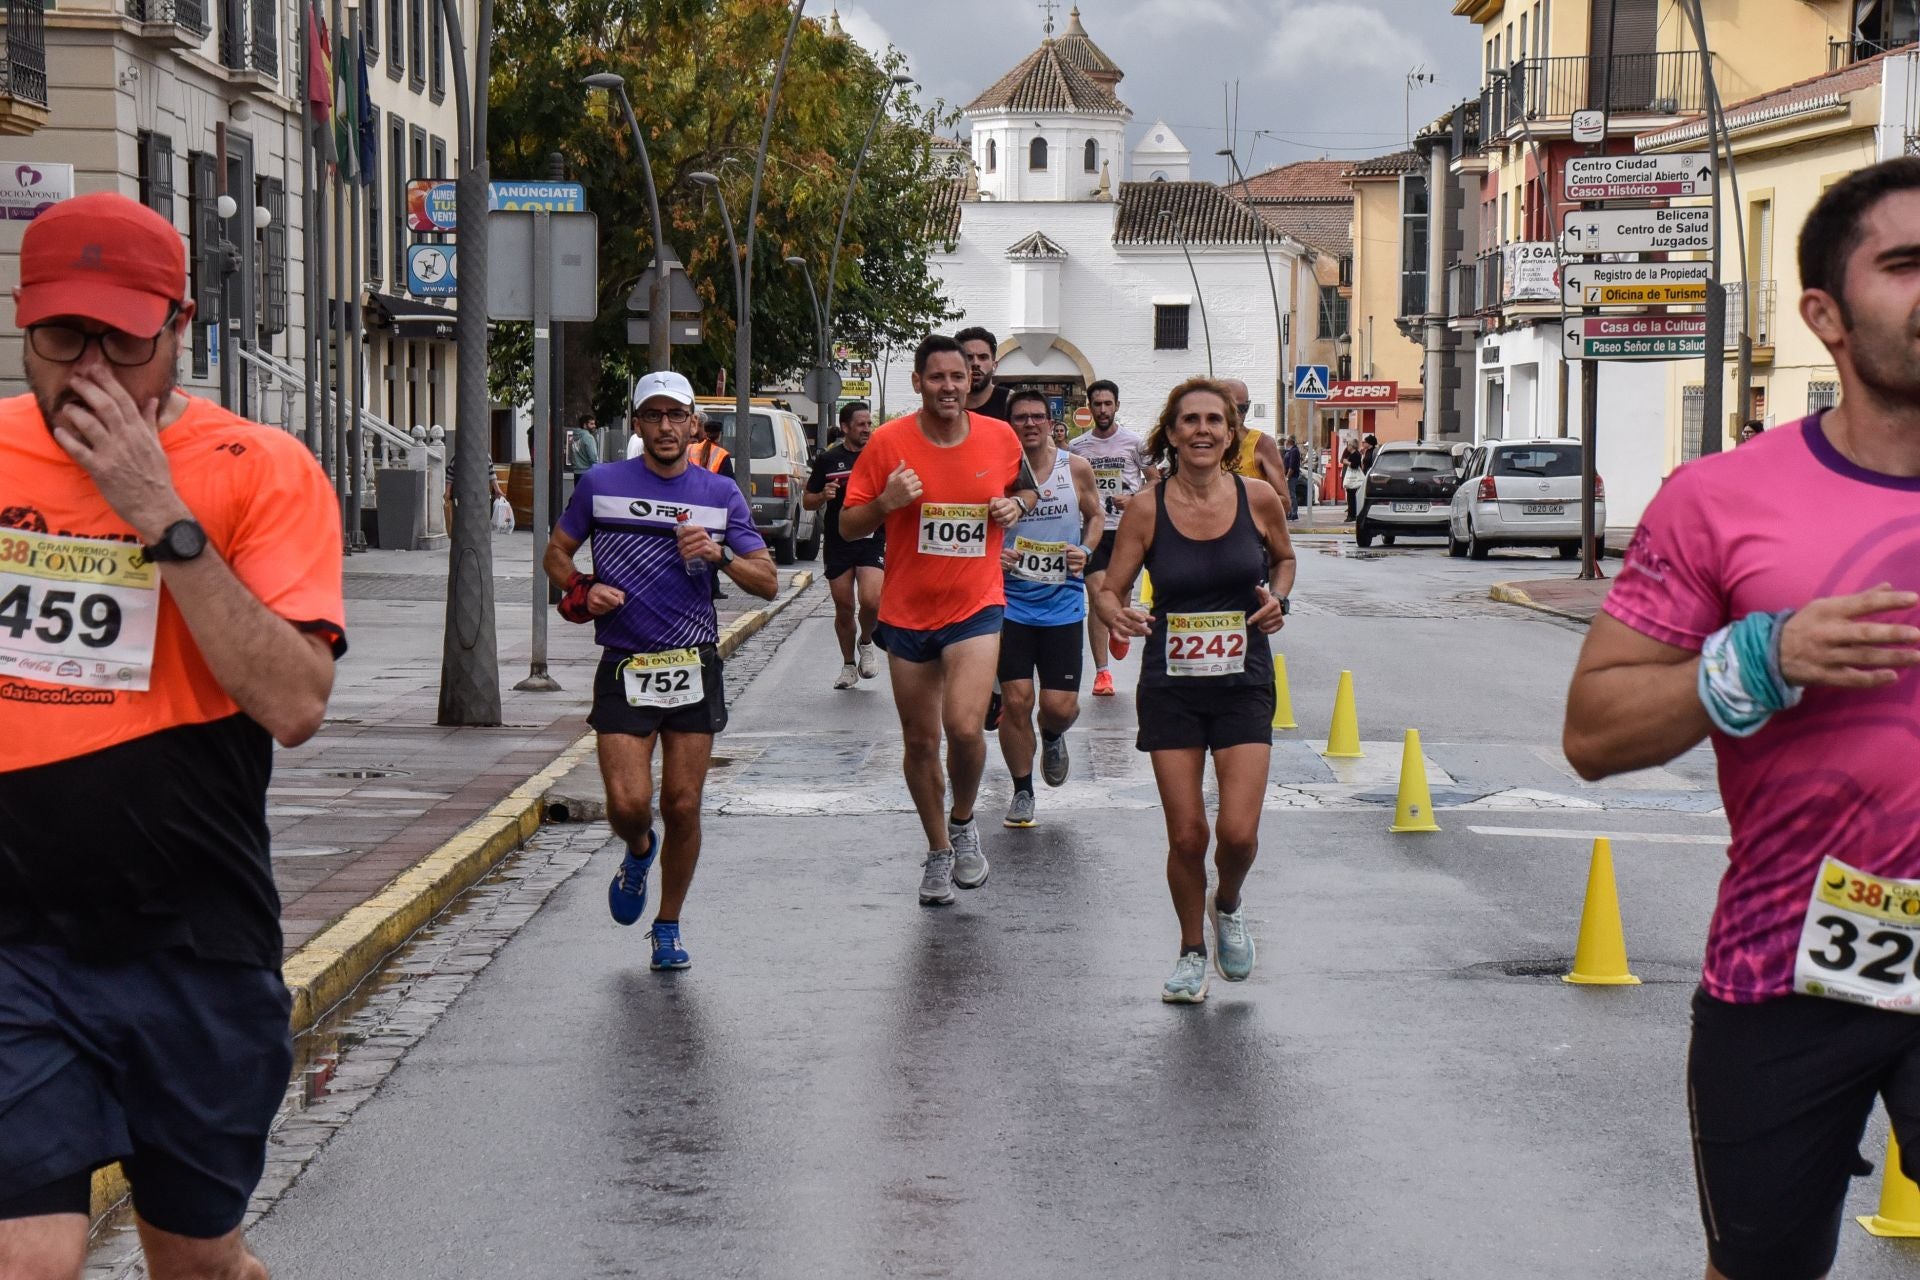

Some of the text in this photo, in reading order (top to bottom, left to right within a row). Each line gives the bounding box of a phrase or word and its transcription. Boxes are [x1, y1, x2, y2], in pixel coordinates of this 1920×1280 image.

[1572, 159, 1657, 171] Centro Ciudad
[1572, 171, 1689, 184] Centro Comercial Abierto
[499, 185, 577, 198] ANÚNCIATE
[1570, 184, 1657, 197] Casco Histórico
[1657, 210, 1709, 220] Belicena
[1617, 223, 1708, 235] Centro de Salud
[1650, 236, 1708, 248] Juzgados
[1522, 248, 1529, 258] 3
[1594, 268, 1707, 282] Registro de la Propiedad
[1606, 289, 1643, 301] Oficina
[1647, 289, 1661, 300] de
[1665, 288, 1706, 299] Turismo
[1600, 321, 1705, 333] Casa de la Cultura
[1593, 339, 1705, 352] Paseo Señor de la Salud
[1344, 385, 1391, 397] CEPSA
[923, 522, 984, 542] 1064
[0, 538, 30, 565] 38
[37, 542, 70, 554] GRAN
[72, 544, 109, 556] PREMIO
[1019, 552, 1065, 572] 1034
[0, 584, 122, 648] 459
[1176, 618, 1186, 628] 38
[1169, 634, 1244, 659] 2242
[636, 670, 690, 693] 752
[2, 684, 113, 704] datacol.com
[1847, 880, 1883, 907] 38
[1808, 916, 1920, 984] 32
